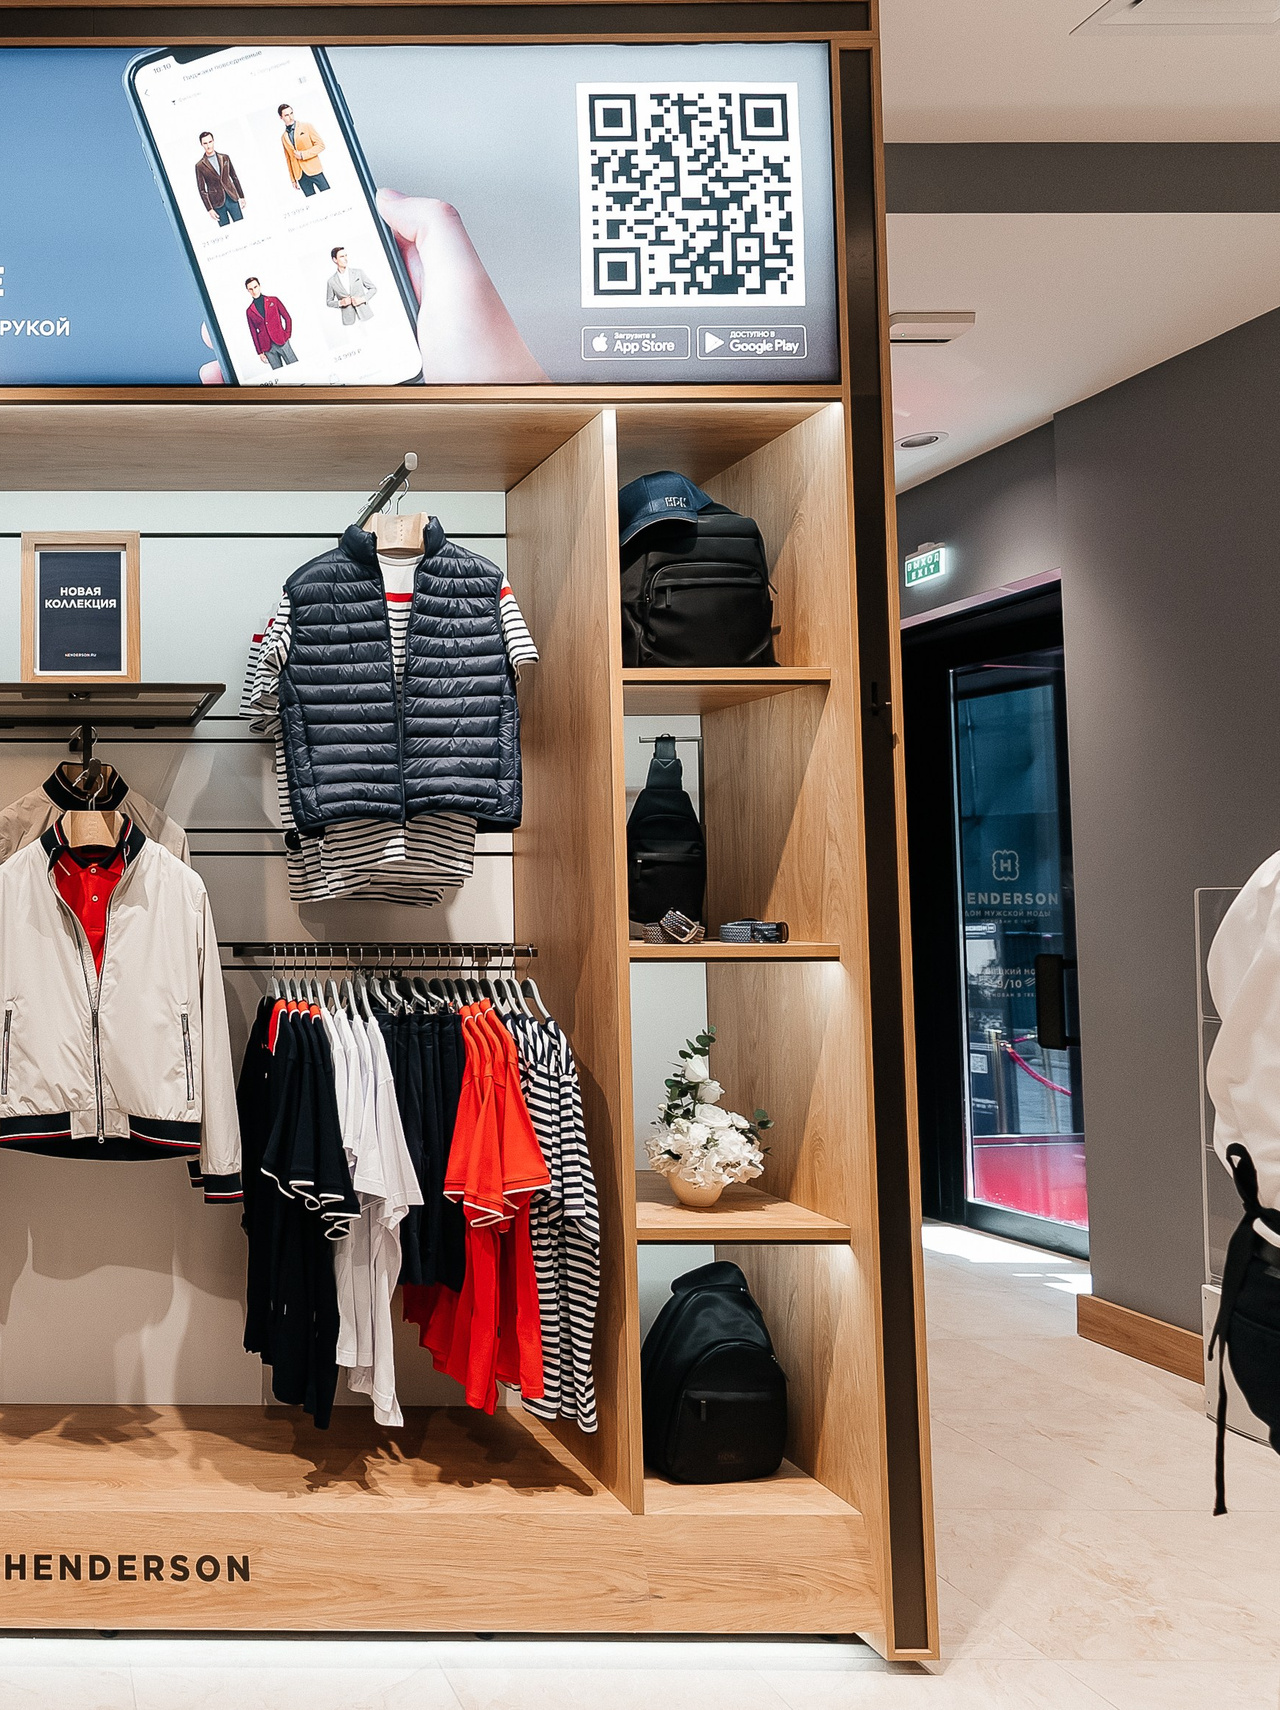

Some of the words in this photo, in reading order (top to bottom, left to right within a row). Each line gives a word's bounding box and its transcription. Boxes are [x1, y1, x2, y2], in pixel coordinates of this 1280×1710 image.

[153, 62, 172, 74] 10:10
[0, 316, 71, 337] РУКОЙ
[614, 332, 651, 340] Загрузите
[729, 331, 769, 339] ДОСТУПНО
[613, 340, 640, 354] App
[641, 340, 675, 352] Store
[729, 339, 773, 354] Google
[774, 339, 800, 354] Play
[907, 552, 940, 572] ВЫХОД
[911, 565, 935, 580] EXIT
[60, 586, 101, 597] НОВАЯ
[44, 599, 117, 610] КОЛЛЕКЦИЯ
[966, 892, 1059, 905] ENDERSON
[5, 1554, 250, 1583] HENDERSON
